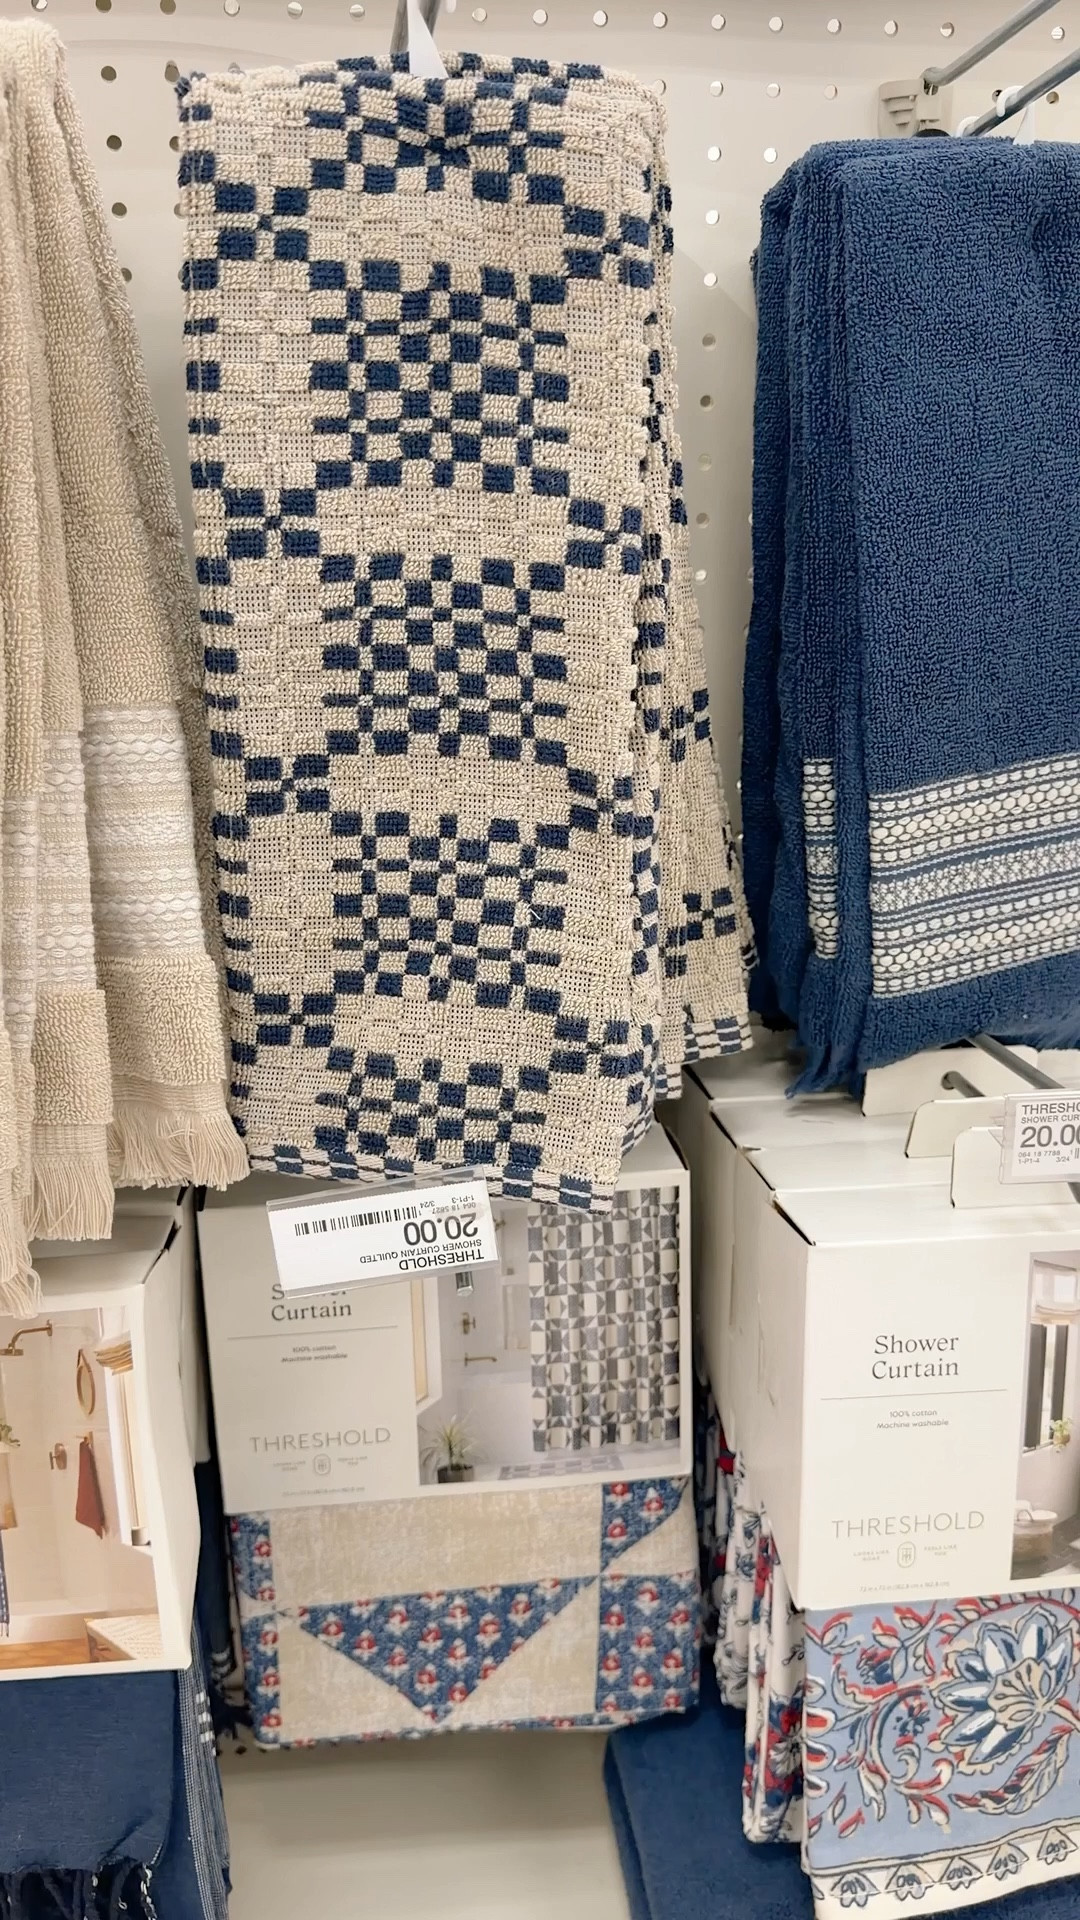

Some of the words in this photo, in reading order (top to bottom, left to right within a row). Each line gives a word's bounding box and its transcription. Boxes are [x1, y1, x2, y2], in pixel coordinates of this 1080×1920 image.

[1020, 1115, 1059, 1124] SHOWER
[1060, 1114, 1080, 1122] CUR
[419, 1200, 435, 1209] 3/24
[451, 1195, 475, 1204] 1-P1-3
[463, 1202, 477, 1210] 064
[403, 1212, 479, 1246] 20.00
[400, 1244, 441, 1257] CURTAIN
[443, 1239, 483, 1252] SHOWER
[360, 1251, 399, 1264] QUILTED
[399, 1248, 485, 1271] THRESHOLD
[271, 1301, 352, 1321] Curtain
[873, 1334, 959, 1355] Shower
[871, 1358, 959, 1380] Curtain
[889, 1410, 910, 1418] 100%
[912, 1419, 949, 1427] washable
[249, 1427, 391, 1453] THRESHOLD
[831, 1510, 985, 1539] THRESHOLD
